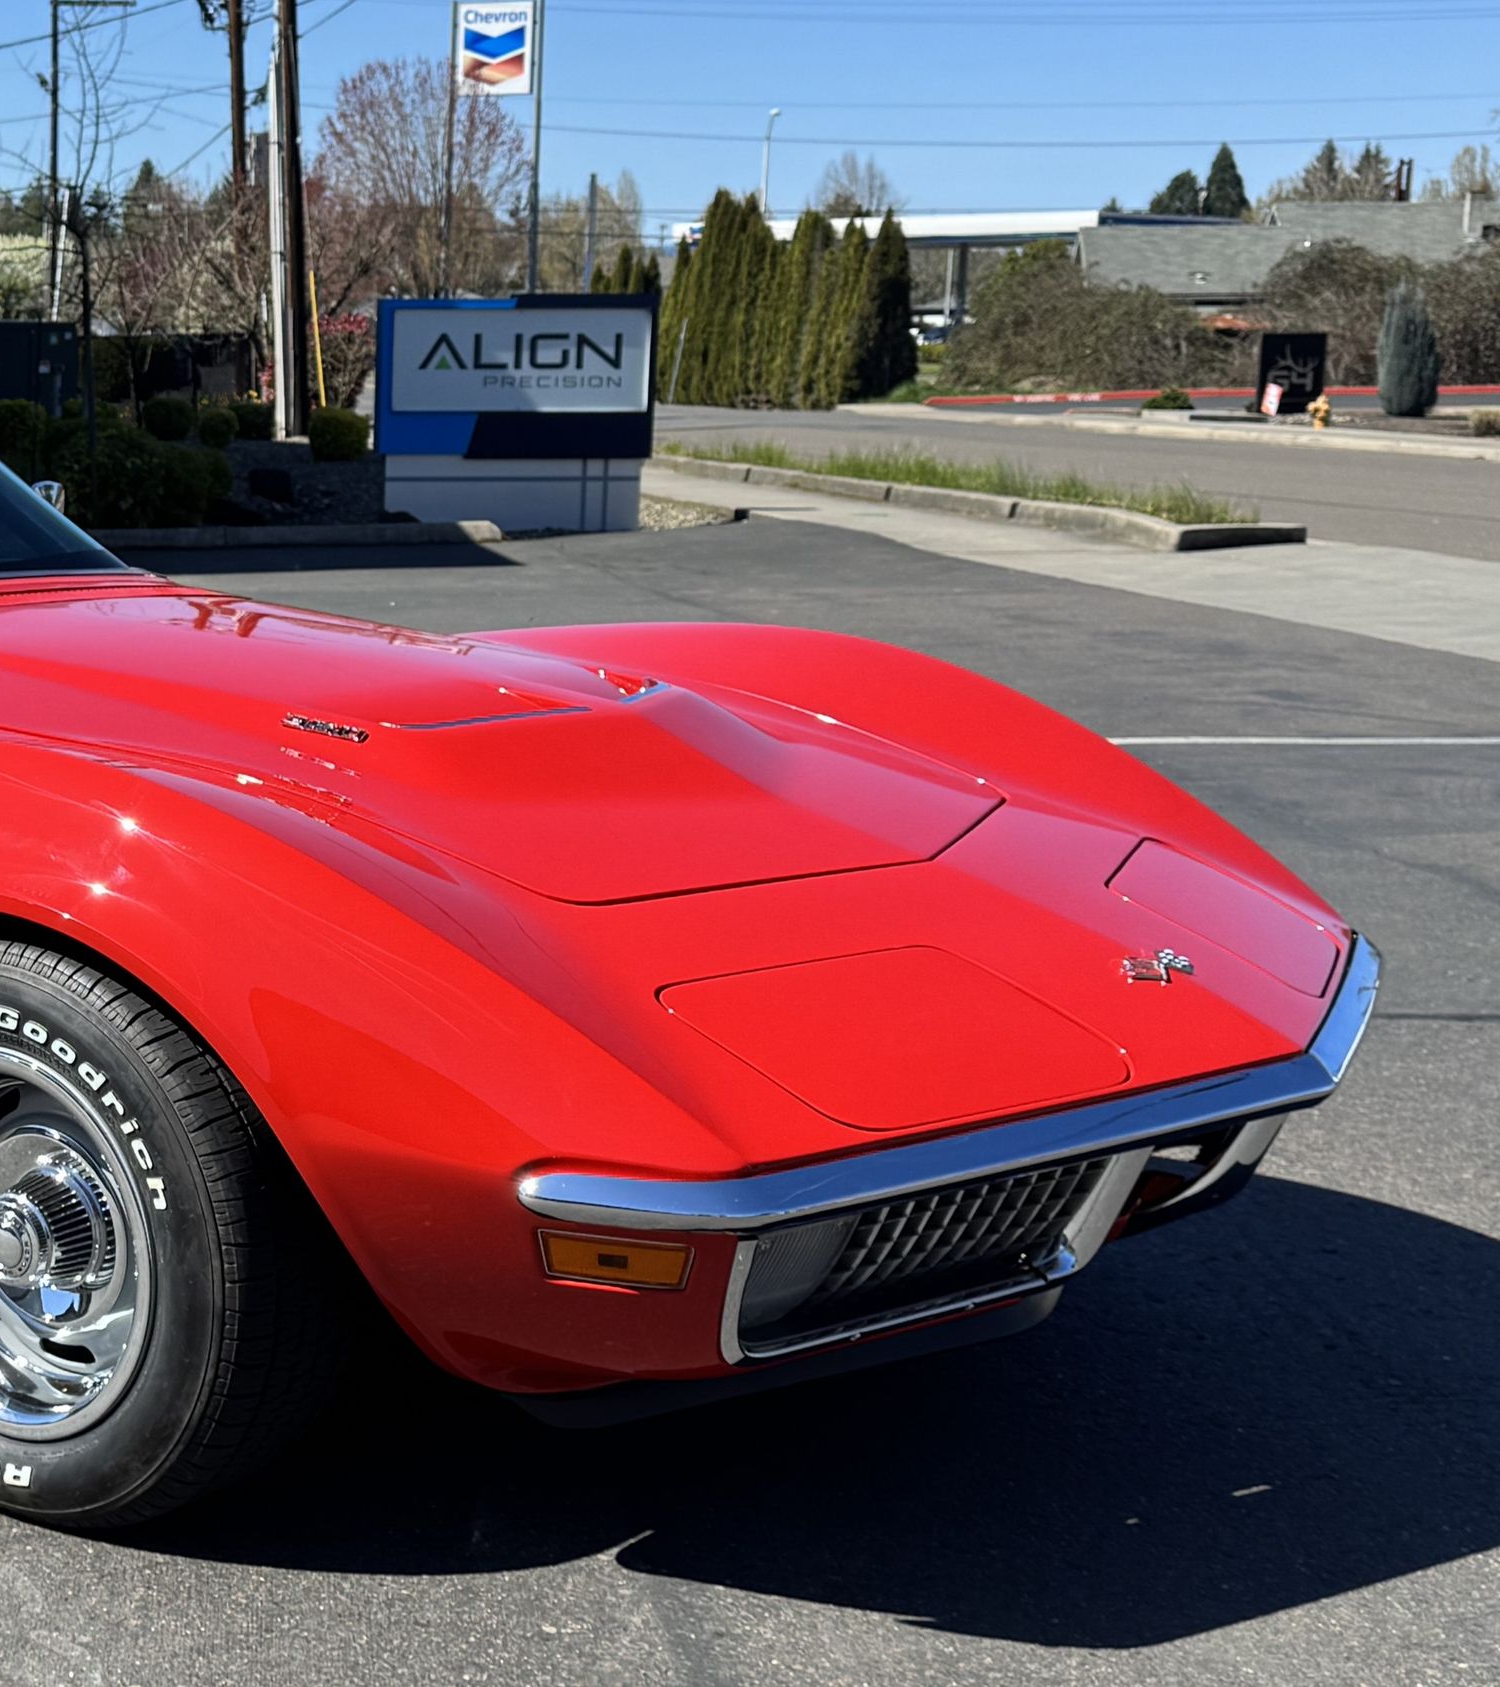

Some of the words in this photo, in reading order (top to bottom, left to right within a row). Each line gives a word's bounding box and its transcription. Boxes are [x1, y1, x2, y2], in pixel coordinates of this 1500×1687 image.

[464, 9, 527, 24] Chevron
[418, 332, 624, 370] ALIGN
[483, 375, 623, 388] PRECISION
